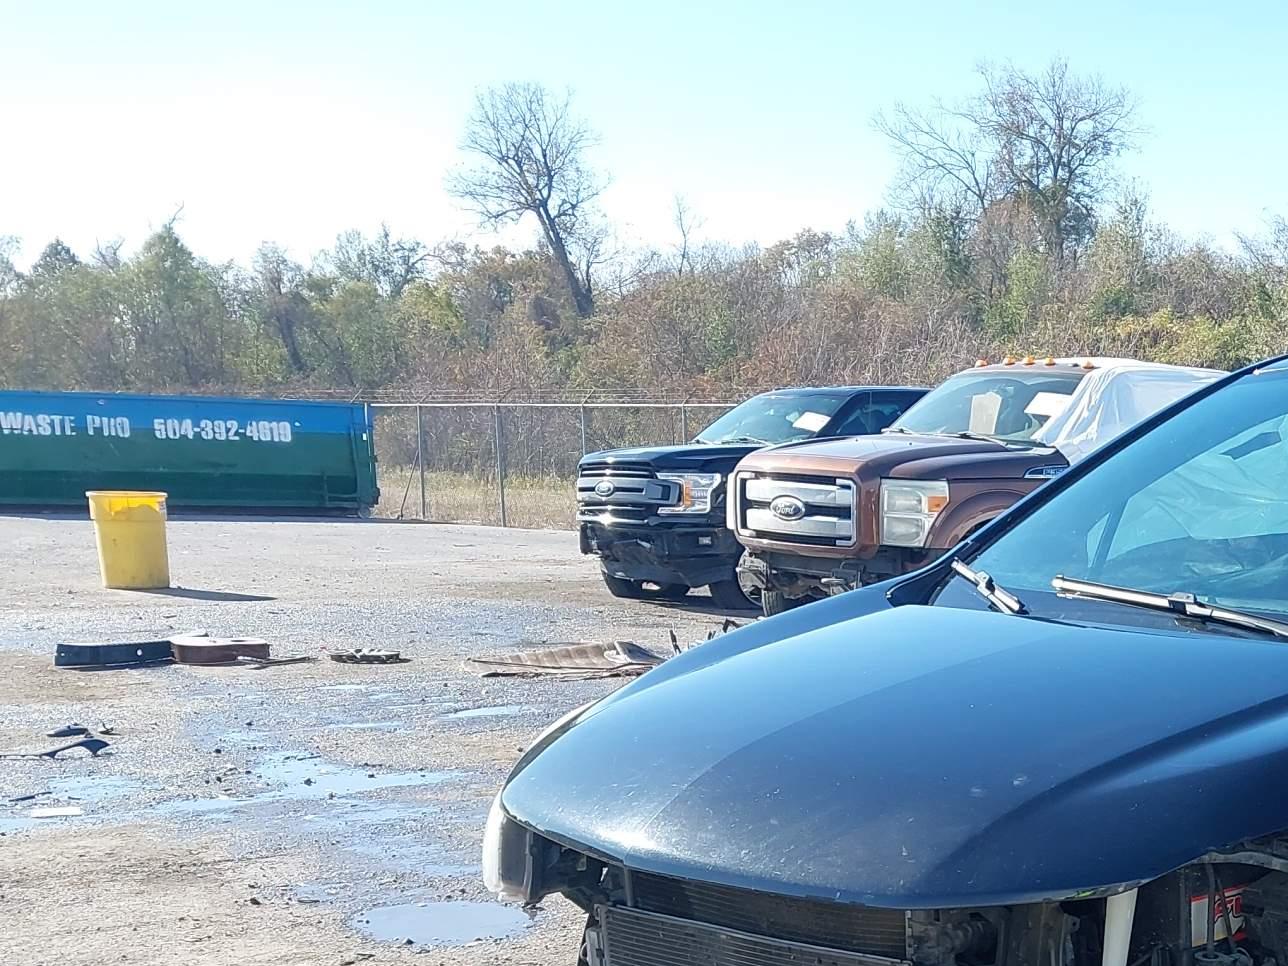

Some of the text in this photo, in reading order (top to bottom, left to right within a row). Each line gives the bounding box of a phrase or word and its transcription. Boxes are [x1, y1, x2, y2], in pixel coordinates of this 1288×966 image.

[0, 411, 292, 442] WASTE PRO 504-392-4619
